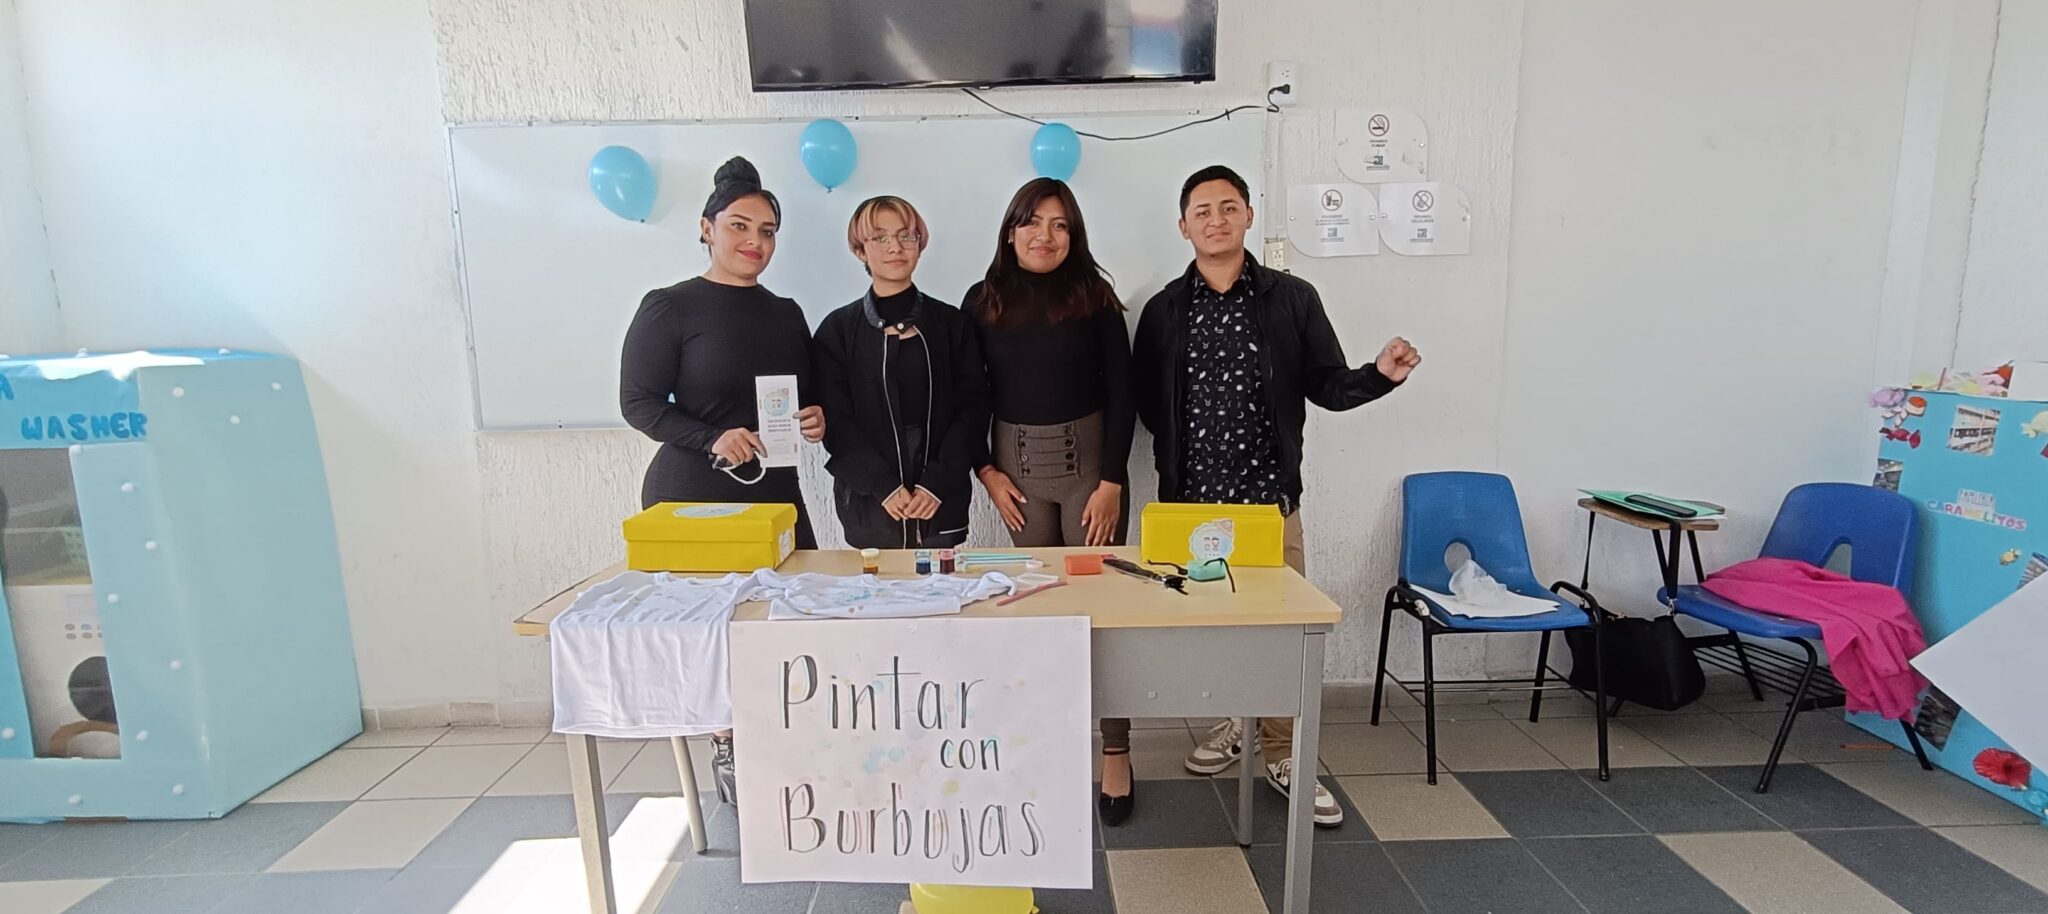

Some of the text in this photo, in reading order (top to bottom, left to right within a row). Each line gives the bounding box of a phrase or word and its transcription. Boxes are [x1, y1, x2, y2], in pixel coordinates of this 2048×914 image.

[21, 411, 148, 441] WASHER
[780, 654, 985, 731] Pintar
[940, 738, 1000, 772] con
[780, 782, 1044, 874] Burbujas
